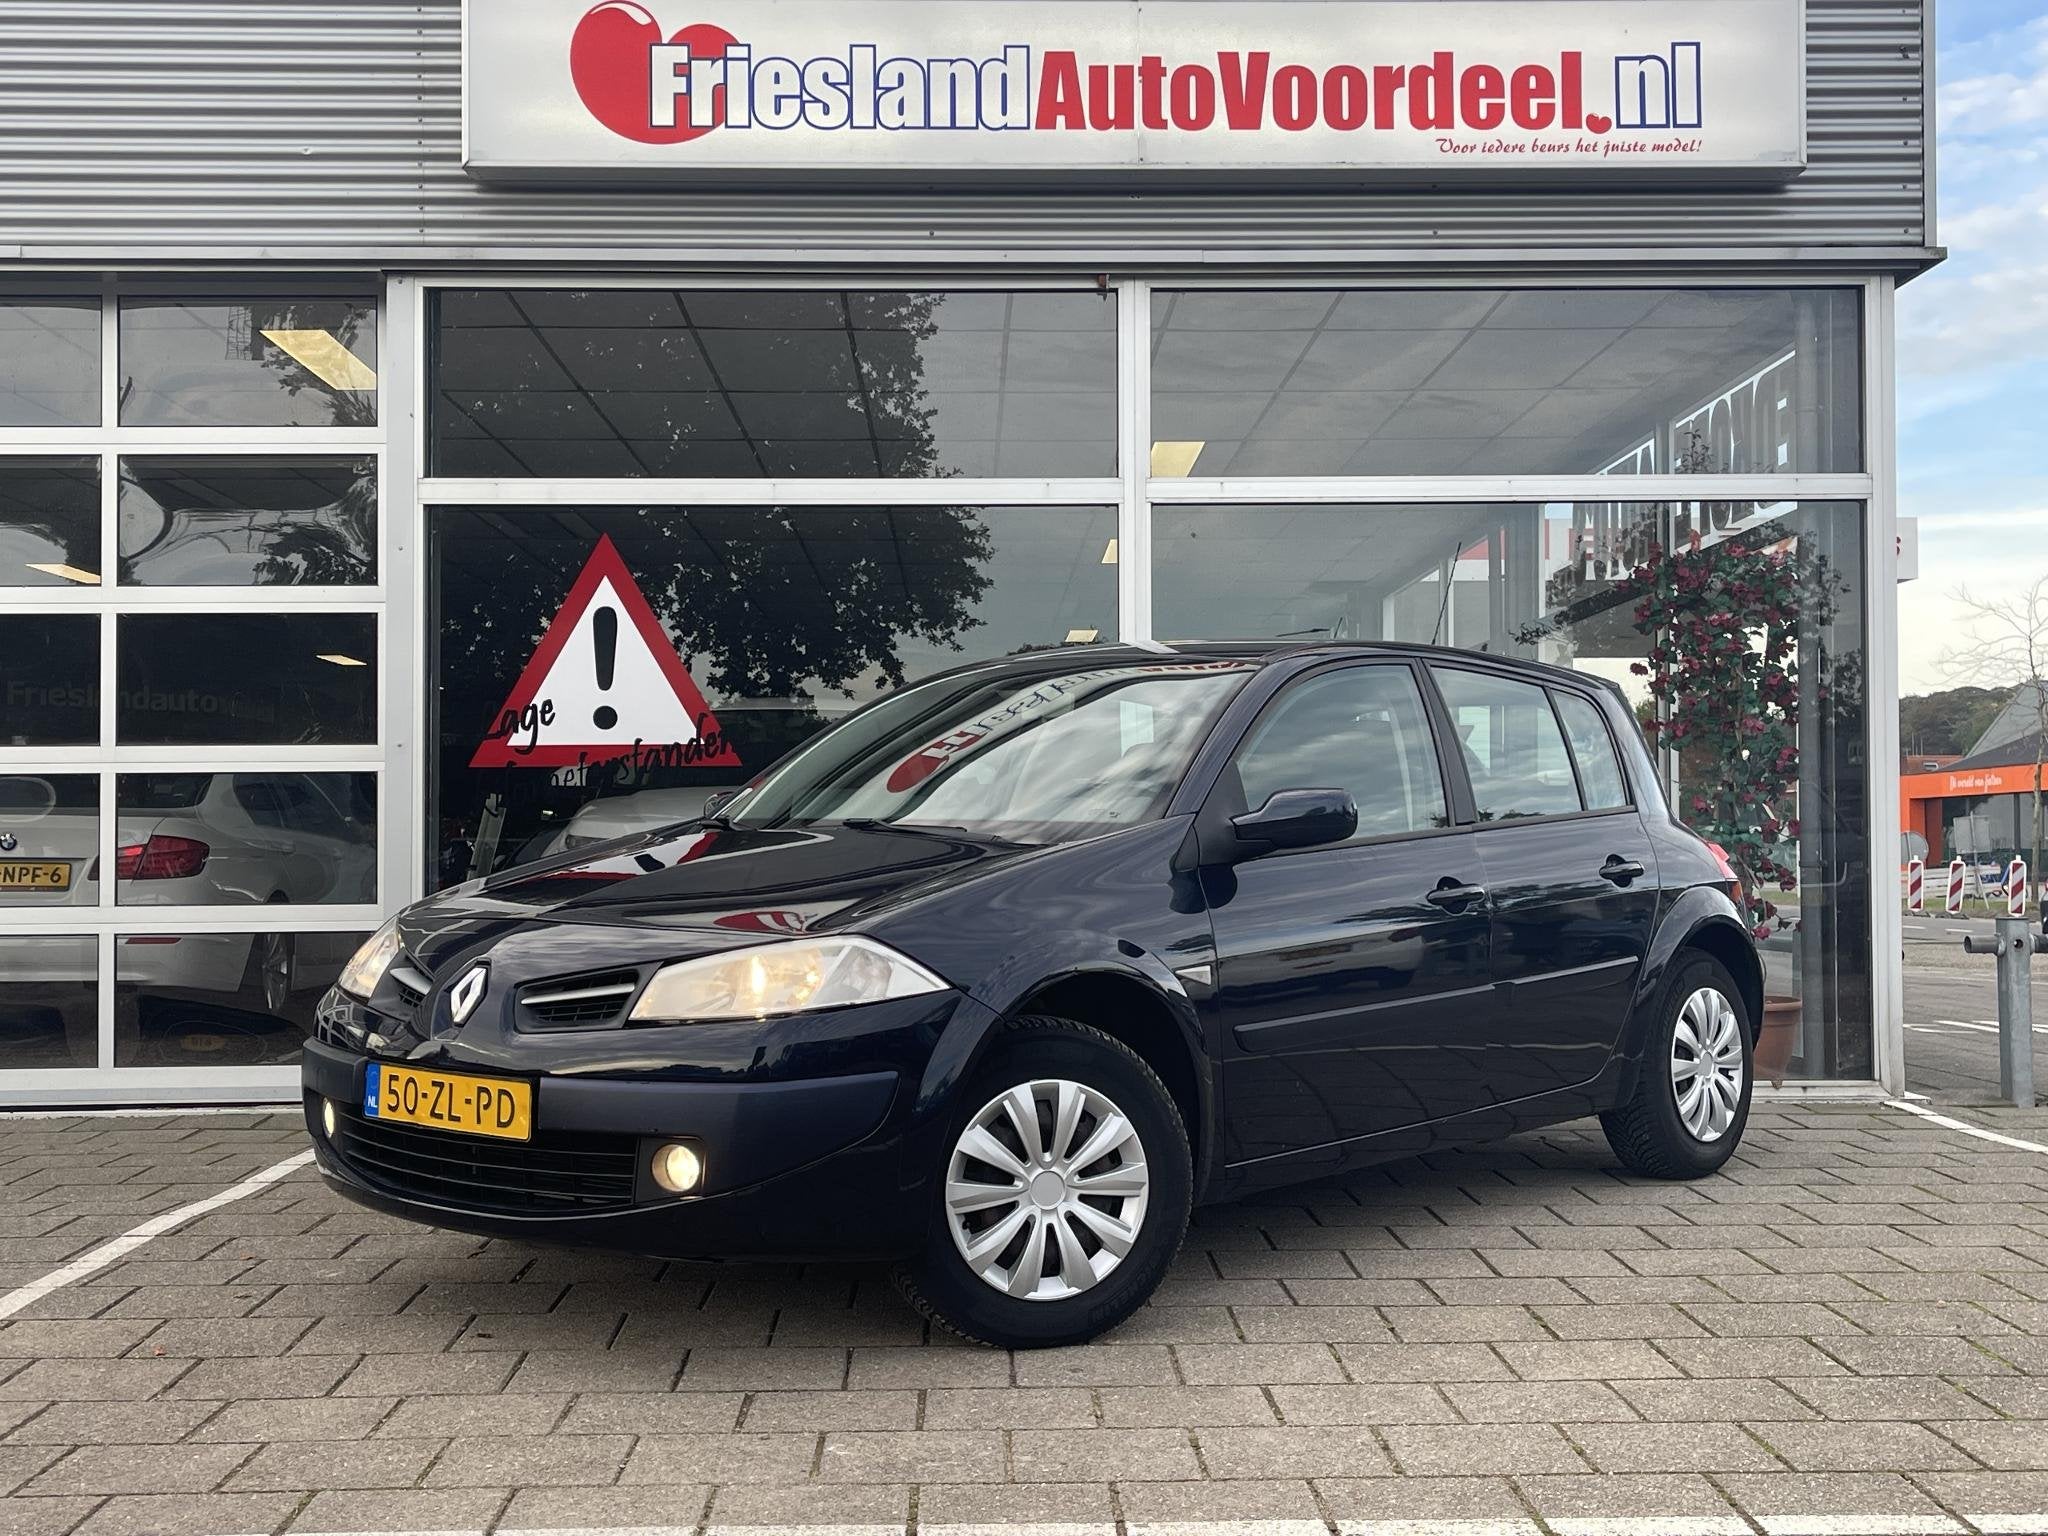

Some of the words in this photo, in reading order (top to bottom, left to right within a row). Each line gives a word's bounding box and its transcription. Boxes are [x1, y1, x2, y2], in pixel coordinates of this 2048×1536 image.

[1435, 138, 1477, 153] Voor
[1481, 138, 1526, 153] iedere
[1531, 138, 1570, 153] beurs
[1575, 137, 1598, 153] het
[1603, 140, 1647, 157] juiste
[1651, 138, 1703, 153] model!
[0, 866, 62, 883] NPF-6
[367, 1095, 378, 1108] NL
[387, 1074, 516, 1128] 50-ZL-PD
